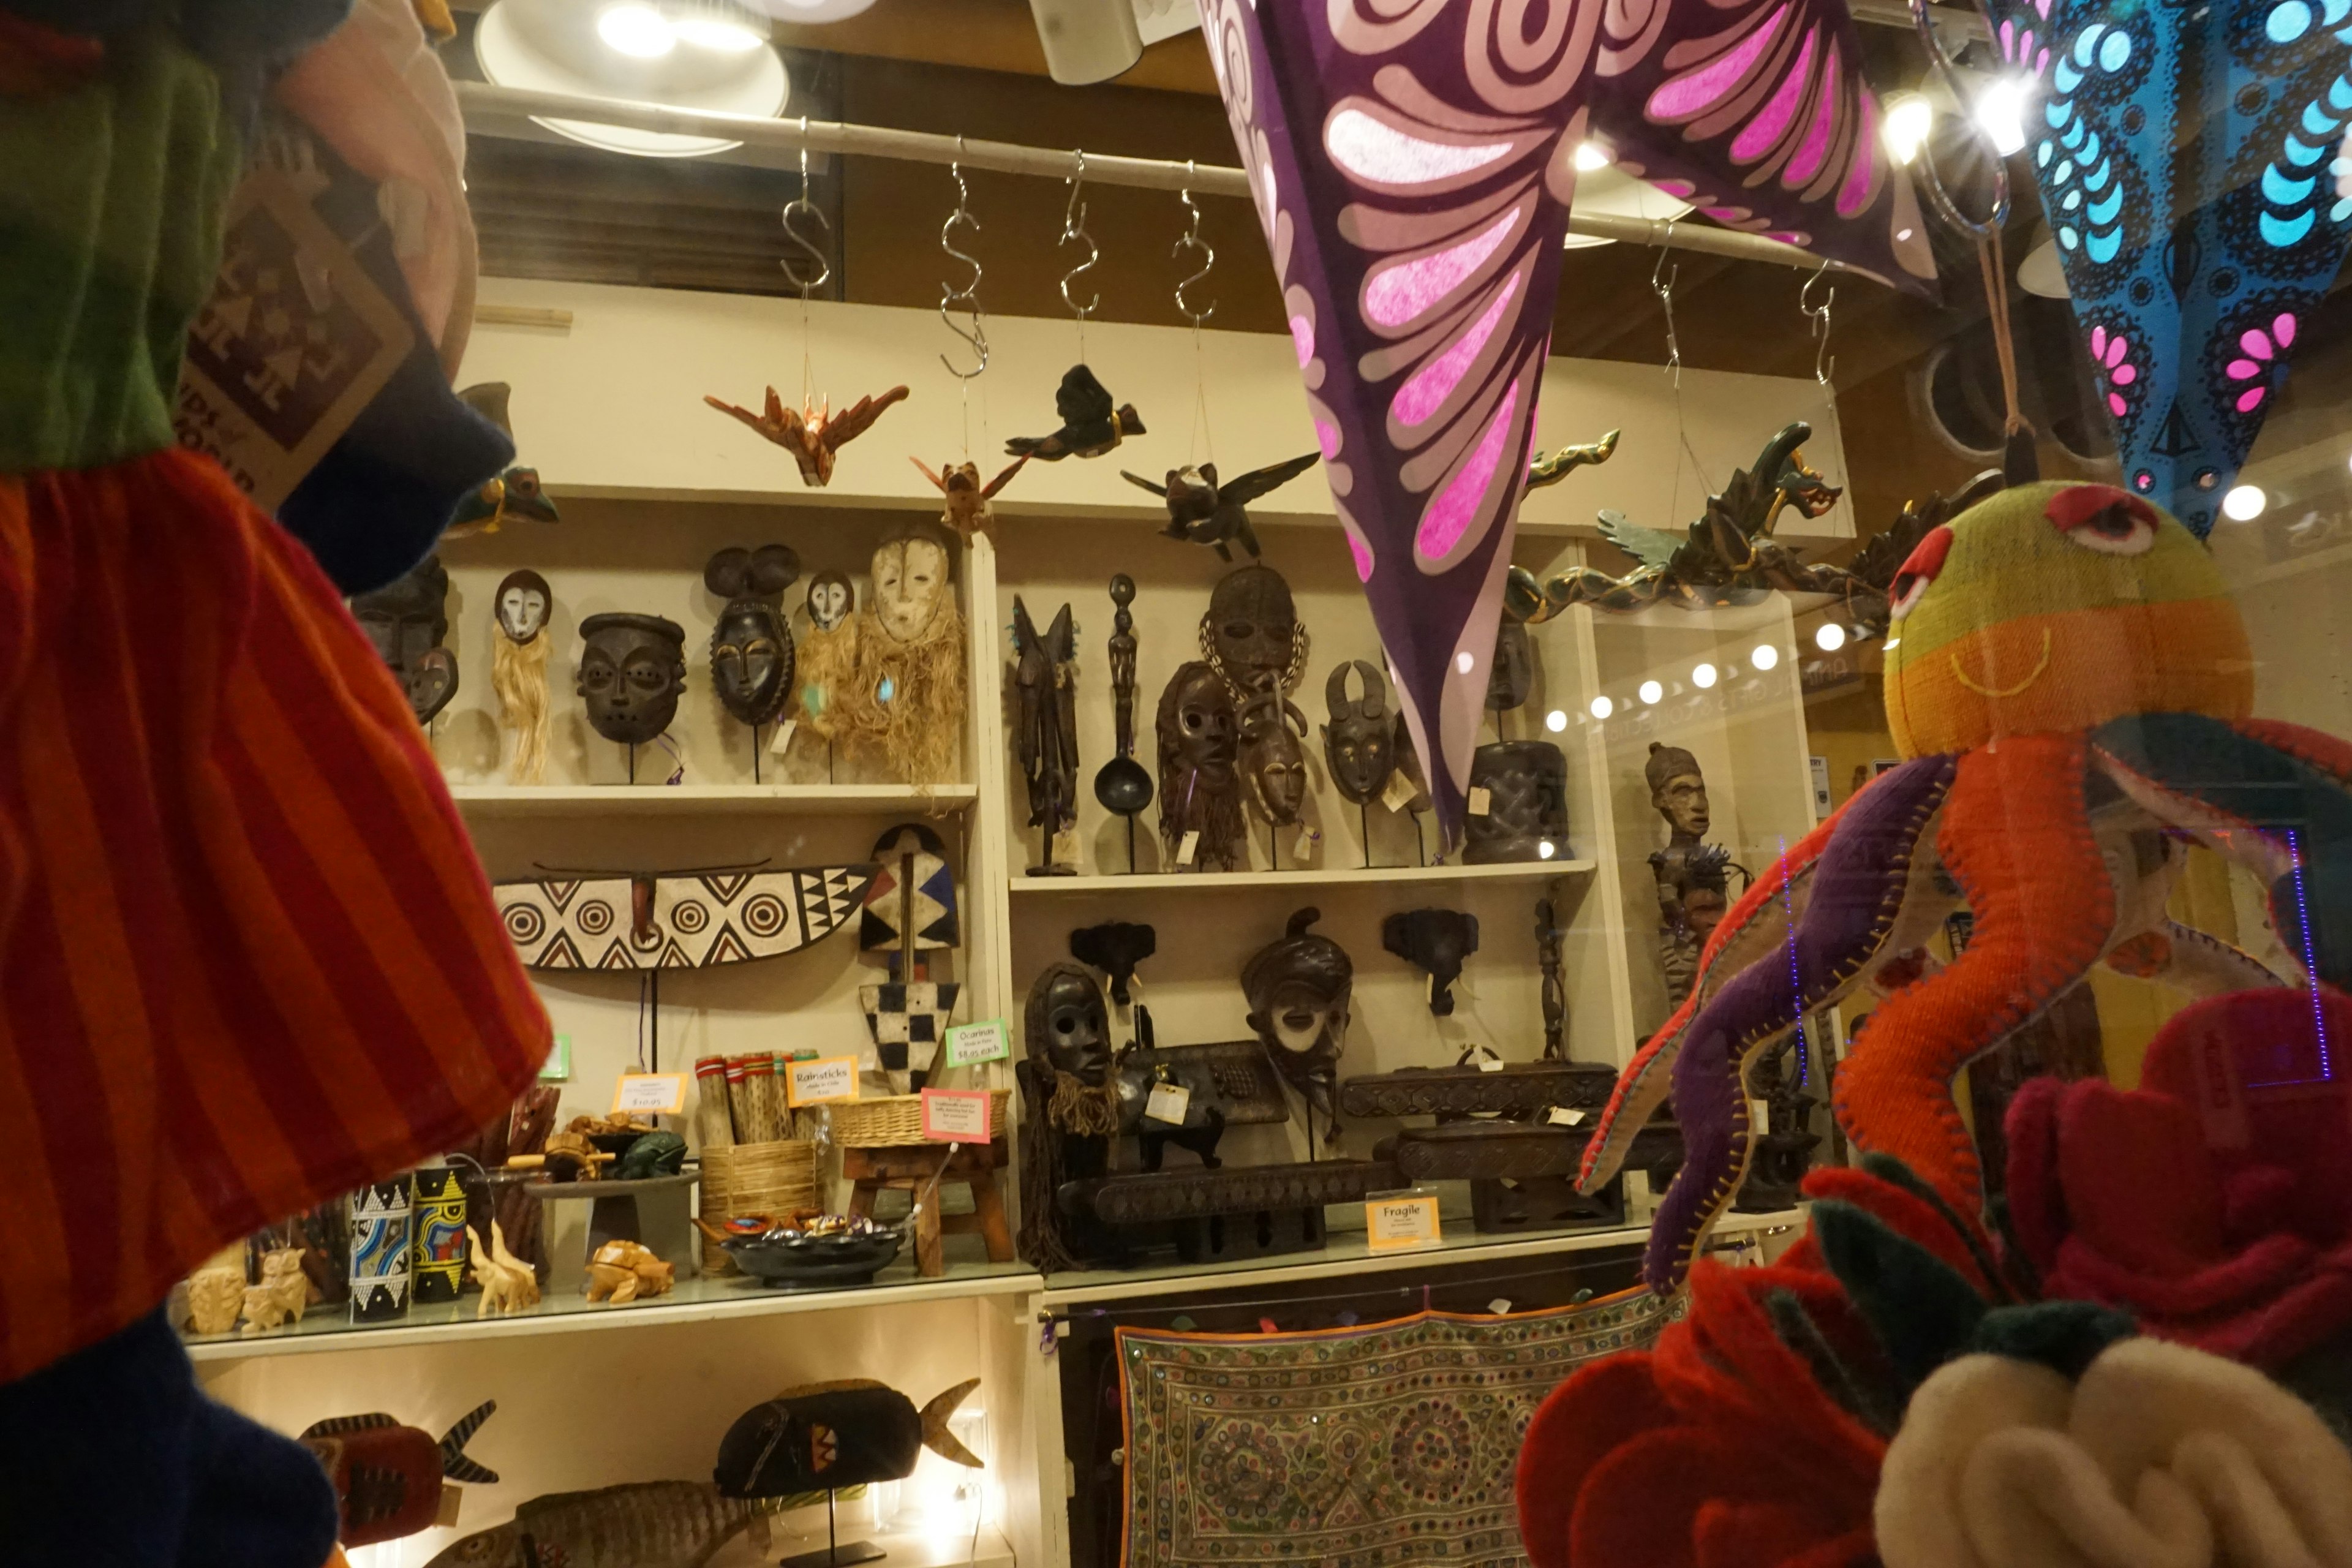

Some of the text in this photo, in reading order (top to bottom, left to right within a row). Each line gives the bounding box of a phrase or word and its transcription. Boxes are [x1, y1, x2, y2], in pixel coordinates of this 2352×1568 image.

[960, 1028, 995, 1040] Ocarinas
[981, 1044, 999, 1054] each
[797, 1068, 847, 1082] Rainsticks
[1383, 1205, 1420, 1218] Fragile
